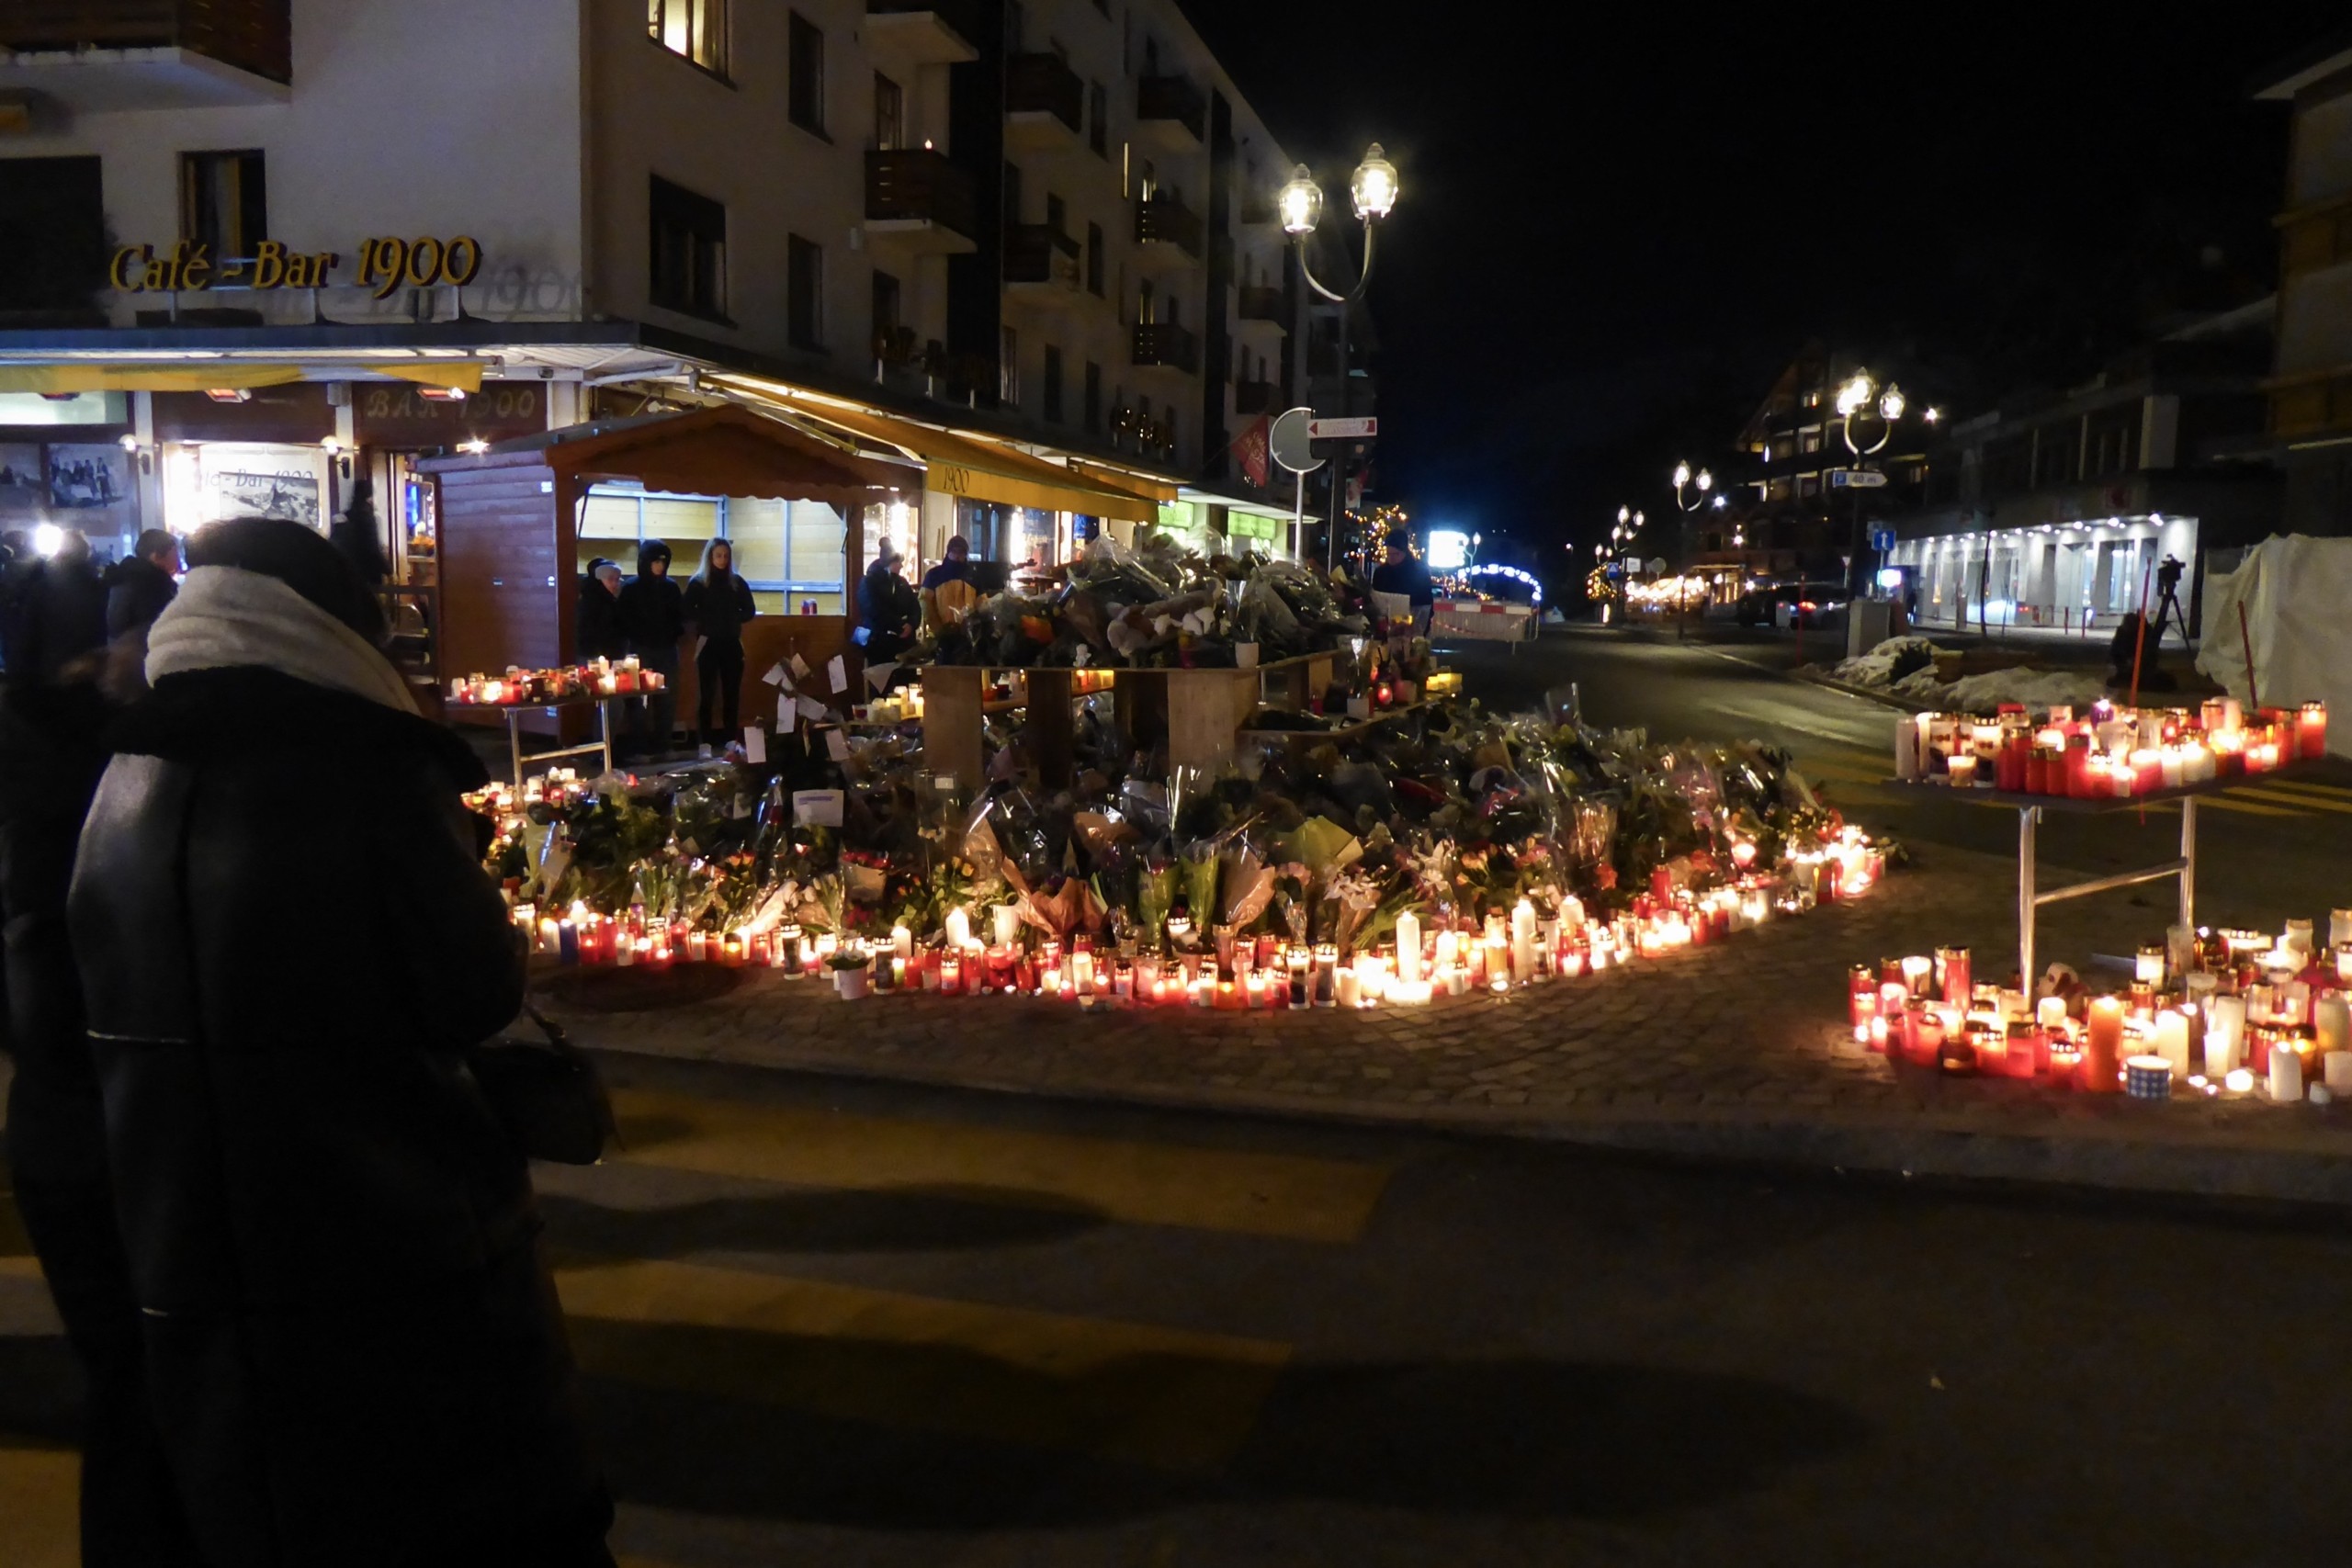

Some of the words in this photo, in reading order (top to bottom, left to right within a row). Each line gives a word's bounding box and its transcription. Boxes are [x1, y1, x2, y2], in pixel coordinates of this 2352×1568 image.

[110, 241, 210, 291] Café
[253, 241, 336, 288] Bar
[356, 236, 481, 299] 1900
[459, 389, 536, 418] 1900
[944, 467, 970, 493] 1900
